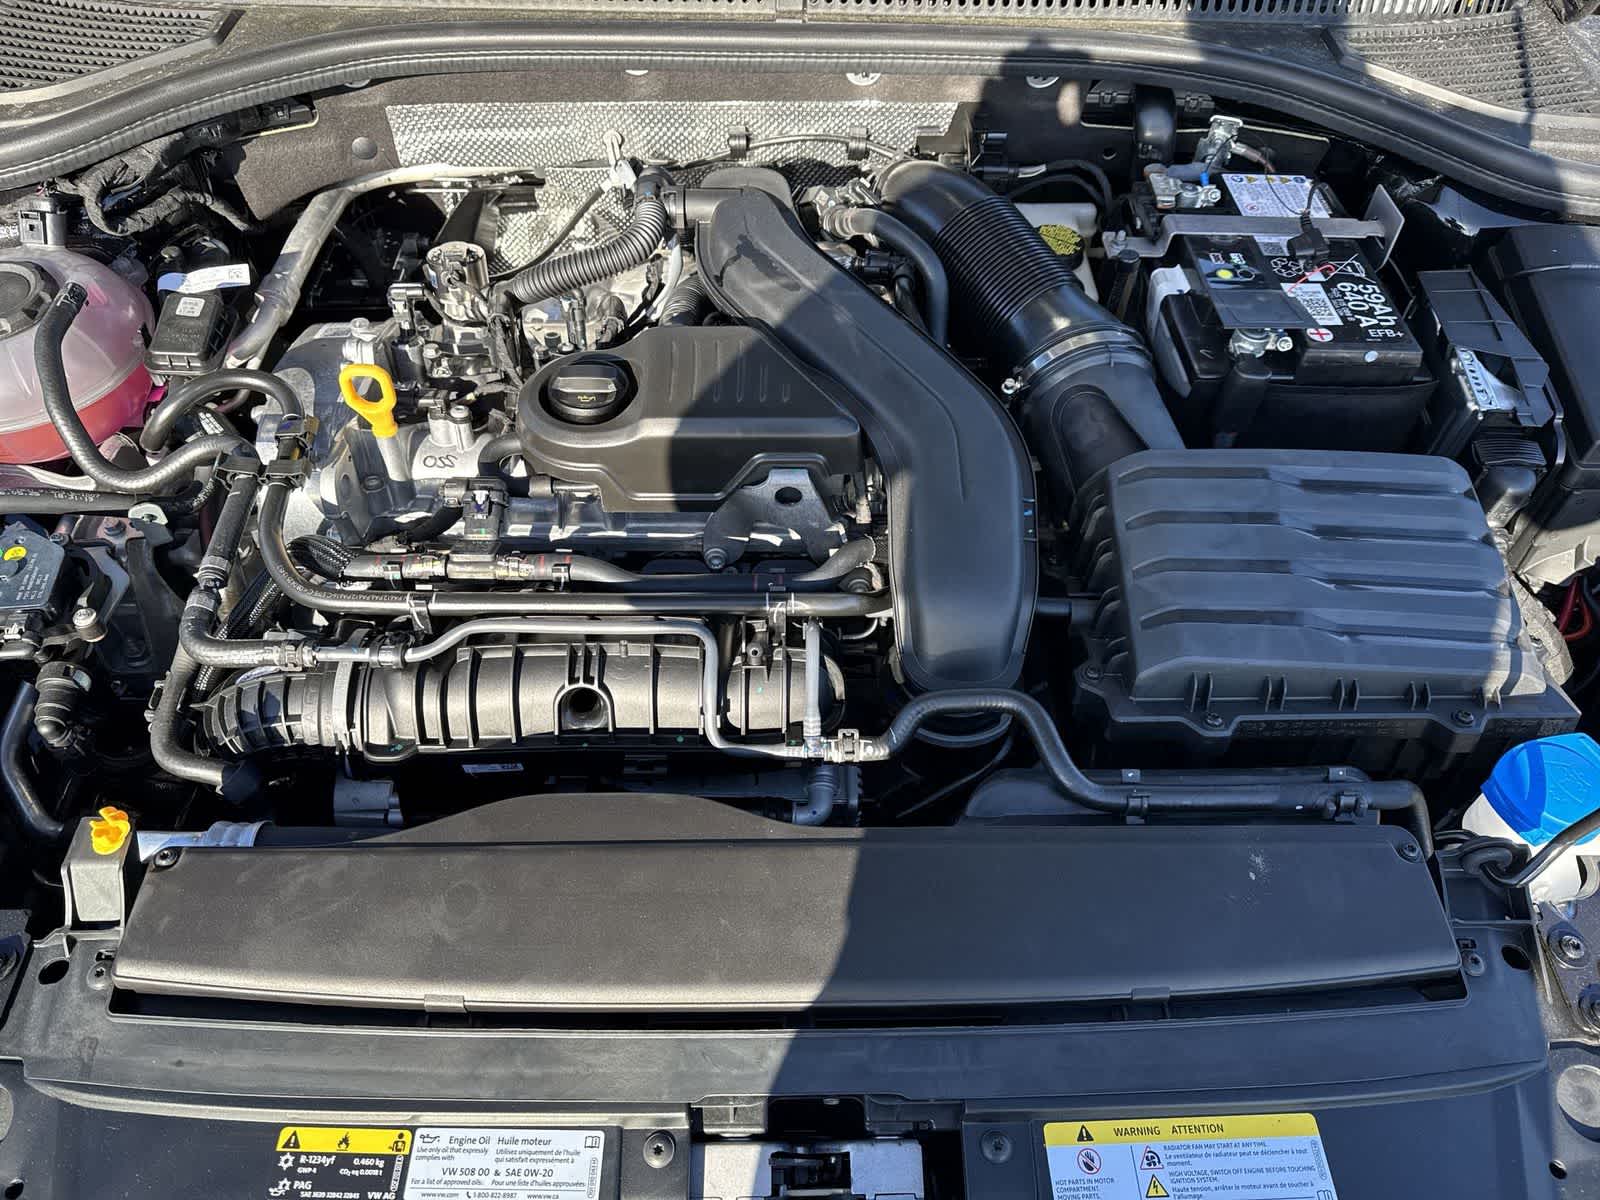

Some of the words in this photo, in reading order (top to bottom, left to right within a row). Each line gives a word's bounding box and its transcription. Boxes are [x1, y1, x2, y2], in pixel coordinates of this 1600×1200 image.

[1337, 282, 1369, 311] 640
[1354, 315, 1379, 327] A
[1358, 284, 1398, 326] 59Ah
[1368, 329, 1405, 338] EFB+
[1113, 1126, 1161, 1137] WARNING
[1171, 1123, 1224, 1135] ATTENTION
[448, 1136, 477, 1147] Engine
[478, 1136, 491, 1145] Oil
[497, 1136, 519, 1146] Huile
[521, 1137, 552, 1146] moteur
[429, 1146, 441, 1155] only
[462, 1147, 489, 1156] expressly
[299, 1155, 336, 1167] R-1234yf
[375, 1158, 385, 1168] kg
[415, 1154, 441, 1162] complies
[442, 1167, 458, 1176] VW
[459, 1167, 476, 1176] 508
[477, 1168, 490, 1176] 00
[494, 1169, 501, 1177] &
[505, 1168, 522, 1177] SAE
[523, 1169, 554, 1177] 0W-20
[1210, 1168, 1232, 1176] SWITCH
[293, 1181, 313, 1190] PAG
[443, 1179, 470, 1187] approved
[1055, 1178, 1068, 1186] HOT
[1068, 1178, 1086, 1186] PARTS
[367, 1192, 383, 1200] VW
[383, 1192, 396, 1200] AG
[1057, 1192, 1081, 1200] MOVING
